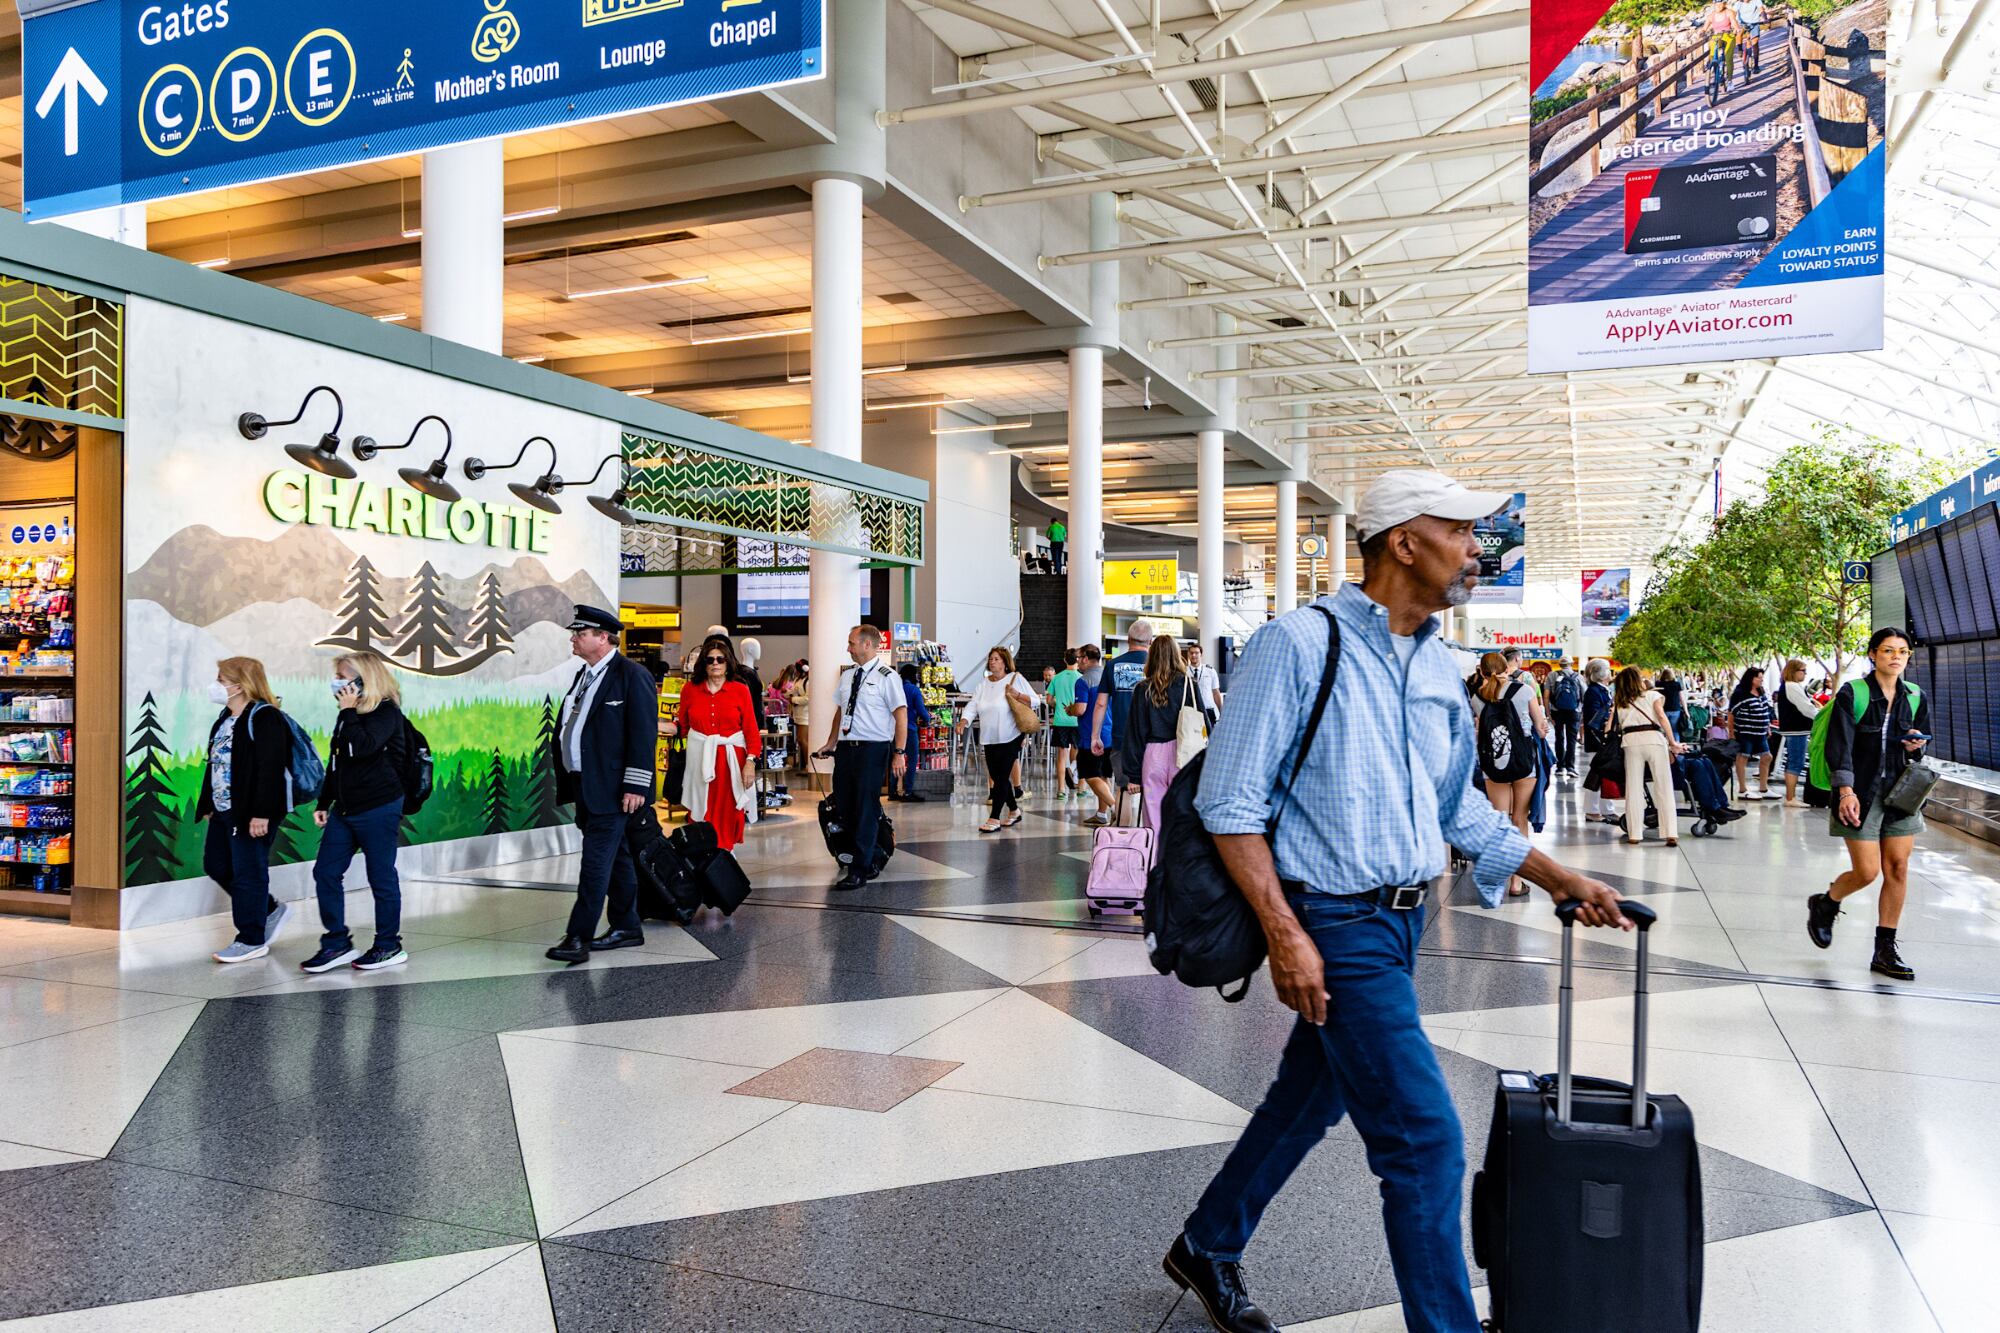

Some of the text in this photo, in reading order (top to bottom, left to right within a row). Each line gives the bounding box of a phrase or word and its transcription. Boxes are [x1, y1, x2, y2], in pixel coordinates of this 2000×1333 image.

[138, 0, 229, 46] Gates
[709, 11, 777, 47] Chapel
[600, 39, 666, 70] Lounge
[309, 49, 333, 97] E
[435, 61, 560, 103] Mother's Room
[231, 68, 261, 114] D
[373, 89, 415, 106] walk time
[154, 83, 184, 129] C
[306, 98, 334, 112] 13 min
[232, 115, 254, 128] 7 min
[1670, 106, 1731, 131] Enjoy
[160, 130, 182, 143] 6 min
[1599, 121, 1806, 162] preferred boarding
[1685, 168, 1750, 184] AAdvantage
[1737, 190, 1768, 199] BARCLAYS
[1640, 234, 1682, 244] CARDMEMBER
[1844, 227, 1877, 239] EARN
[1634, 257, 1661, 267] Terms
[1662, 255, 1681, 265] and
[1682, 250, 1733, 263] Conditions
[1782, 240, 1877, 259] LOYALTY POINTS
[1778, 259, 1831, 272] TOWARD
[1606, 312, 1793, 342] ApplyAviator.com
[263, 468, 557, 553] CHARLOTTE
